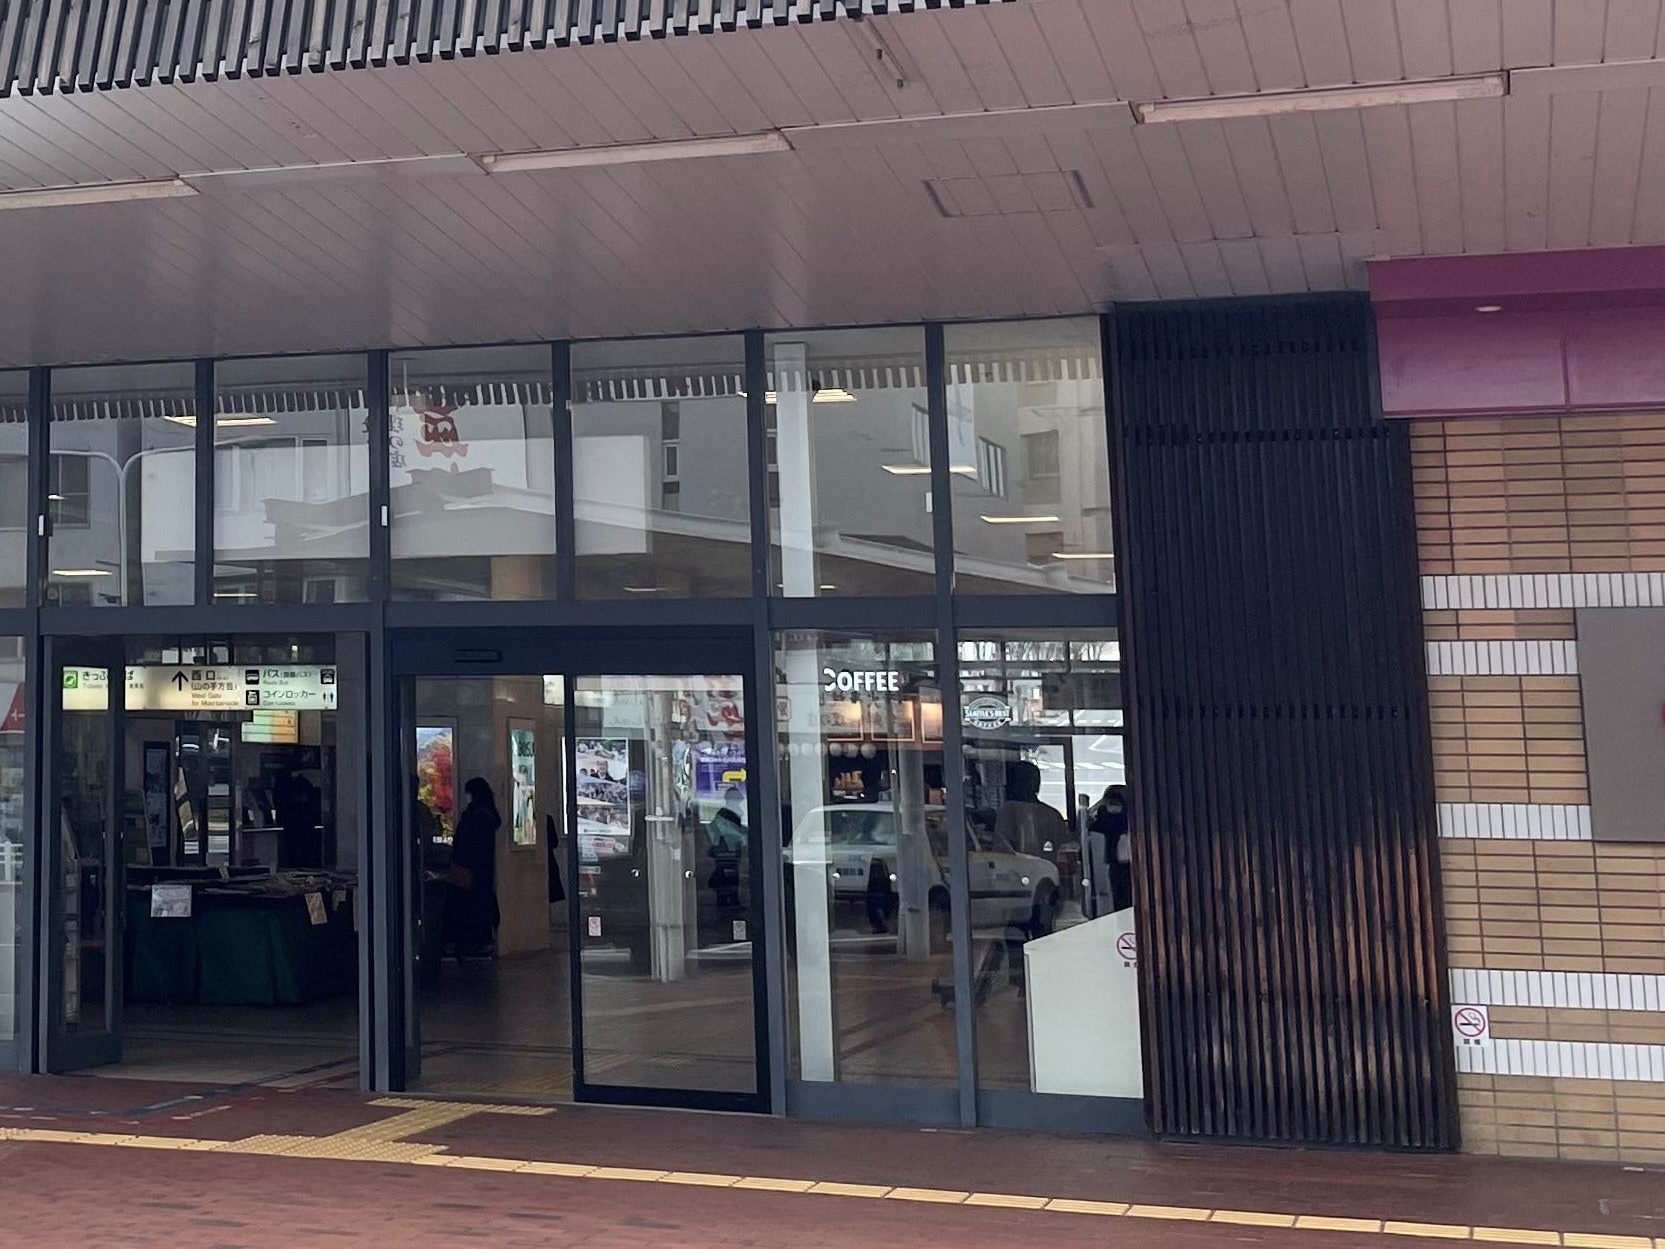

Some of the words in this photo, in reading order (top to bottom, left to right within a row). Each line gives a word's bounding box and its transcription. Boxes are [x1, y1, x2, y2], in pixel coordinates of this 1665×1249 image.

[262, 690, 317, 700] コインロッカー
